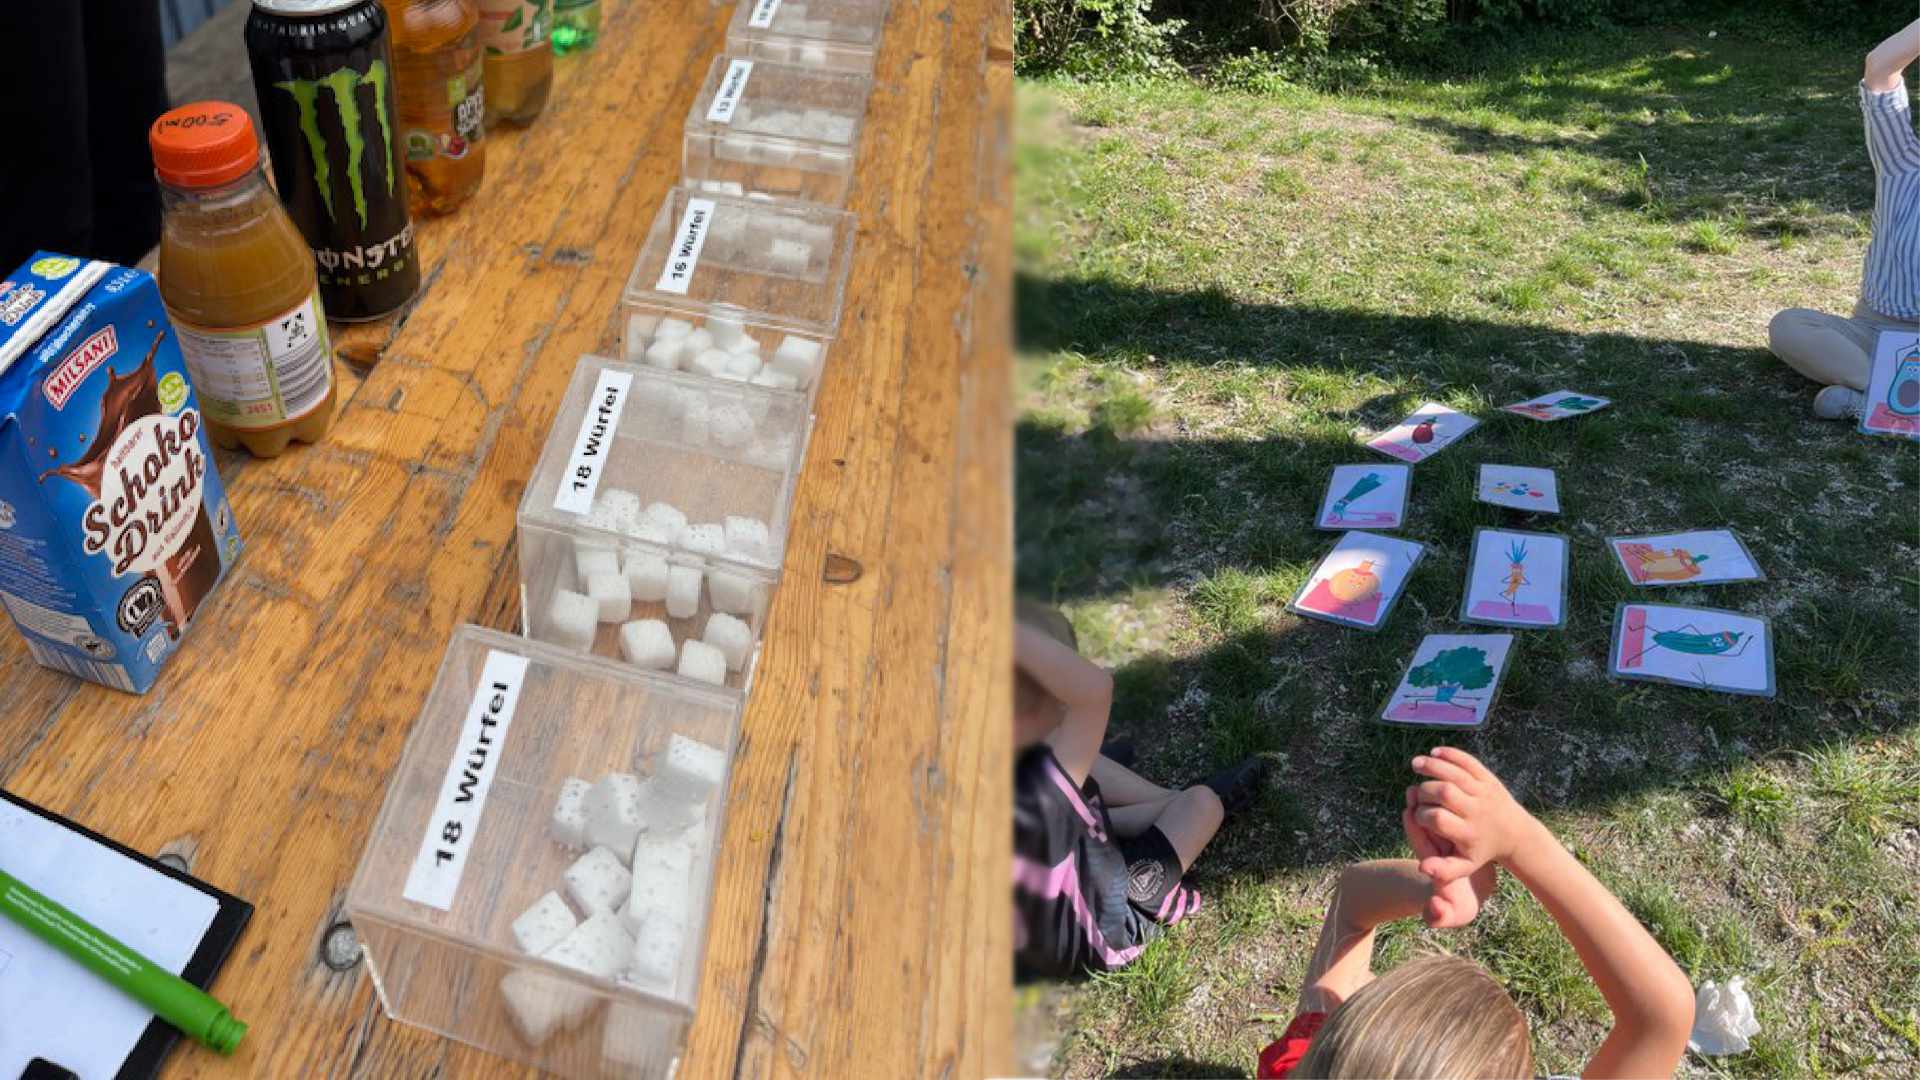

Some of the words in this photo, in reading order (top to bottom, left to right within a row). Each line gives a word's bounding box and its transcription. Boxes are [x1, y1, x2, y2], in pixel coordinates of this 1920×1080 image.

[672, 262, 687, 280] 16
[679, 209, 705, 257] Würfel
[51, 334, 112, 396] MILSANI
[86, 411, 197, 550] Schoko
[573, 465, 592, 492] 18
[583, 386, 618, 456] Würfel
[115, 449, 203, 574] Drink
[436, 820, 463, 867] 18
[454, 681, 508, 802] Würfel
